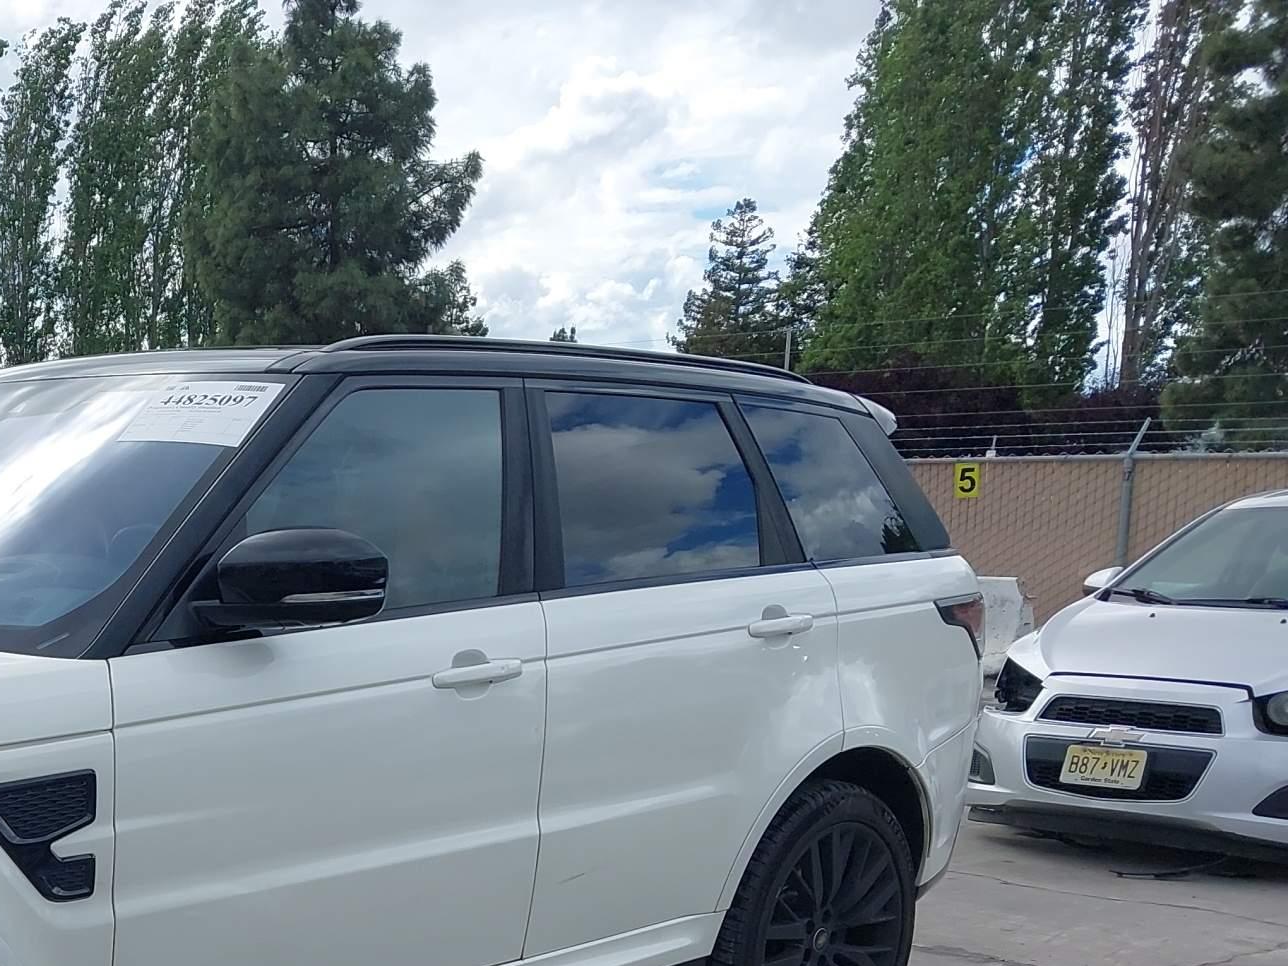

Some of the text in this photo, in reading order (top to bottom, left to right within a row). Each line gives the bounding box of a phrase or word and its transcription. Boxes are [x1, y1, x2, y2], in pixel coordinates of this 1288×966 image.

[160, 394, 258, 407] 44825097
[959, 467, 976, 493] 5
[1068, 755, 1140, 779] B87 VMZ
